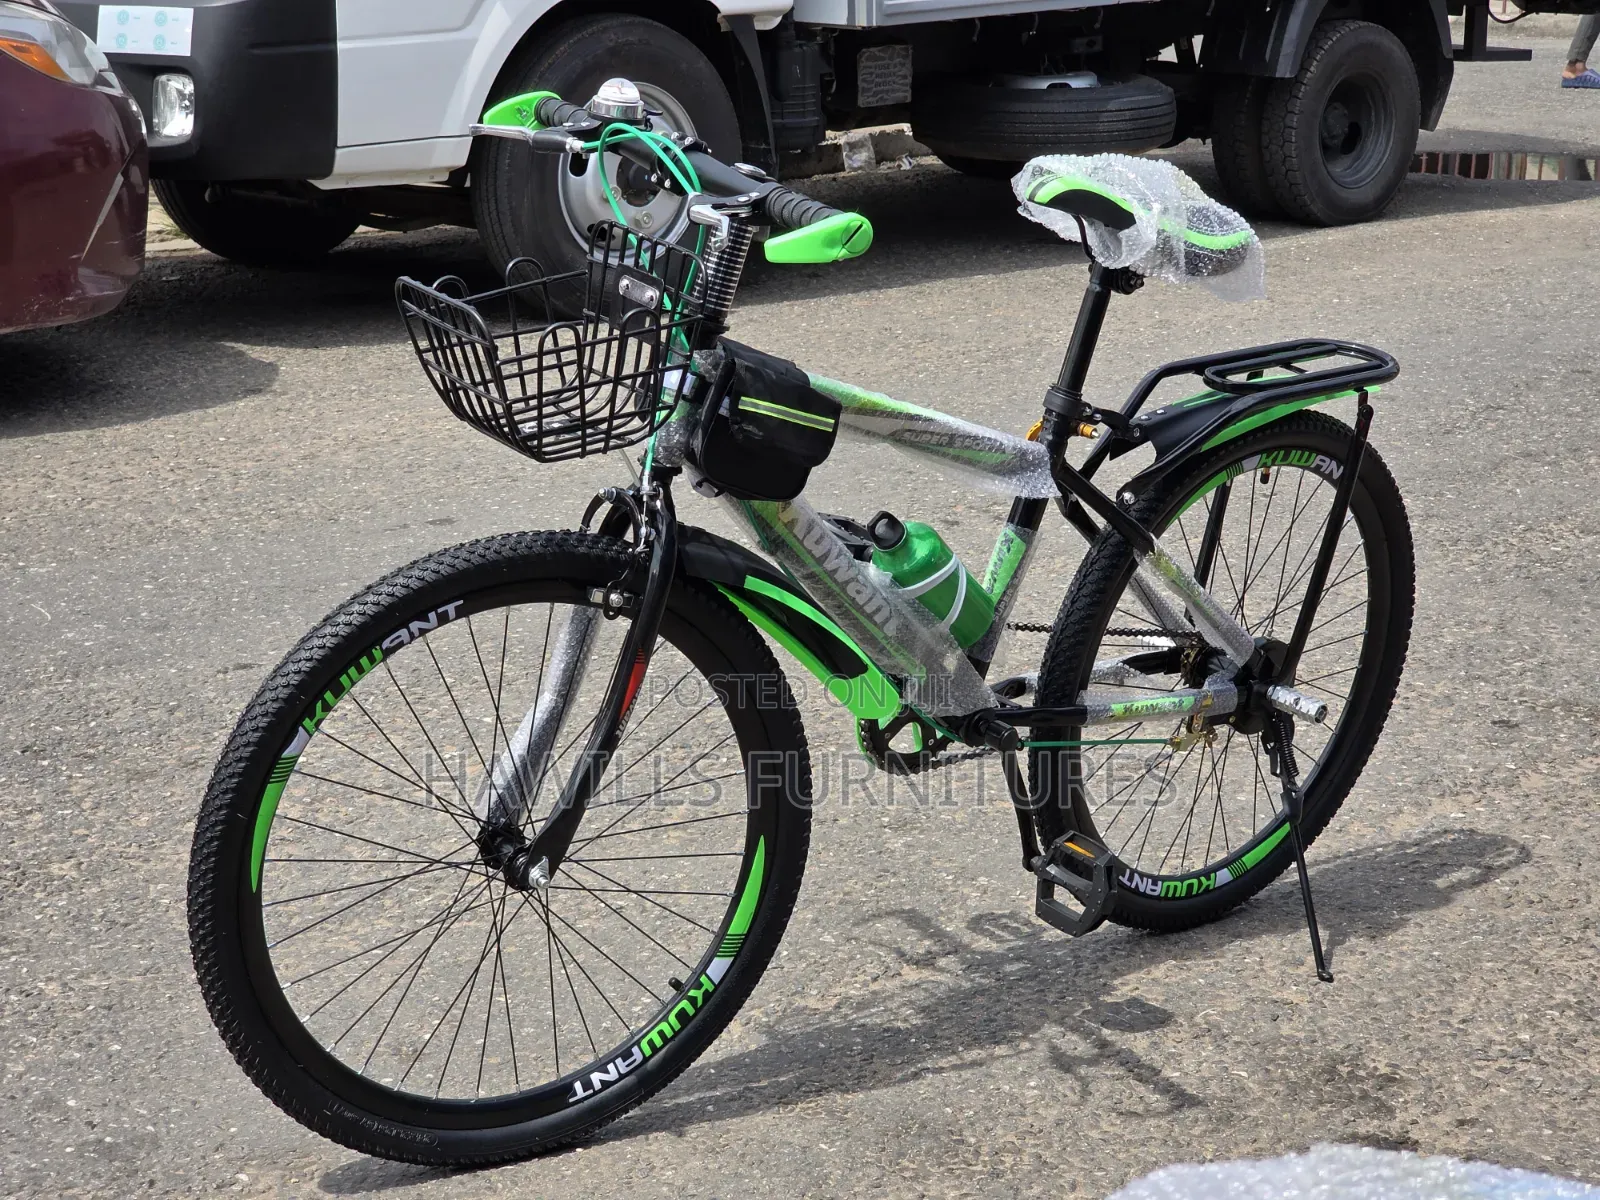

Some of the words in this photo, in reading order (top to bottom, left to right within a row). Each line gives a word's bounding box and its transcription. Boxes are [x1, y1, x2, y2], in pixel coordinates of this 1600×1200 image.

[900, 430, 950, 448] SUPER
[1257, 450, 1344, 480] KUWAN
[302, 600, 464, 735] KUWANT
[1118, 868, 1216, 898] KUWANT
[568, 973, 715, 1103] KUWANT
